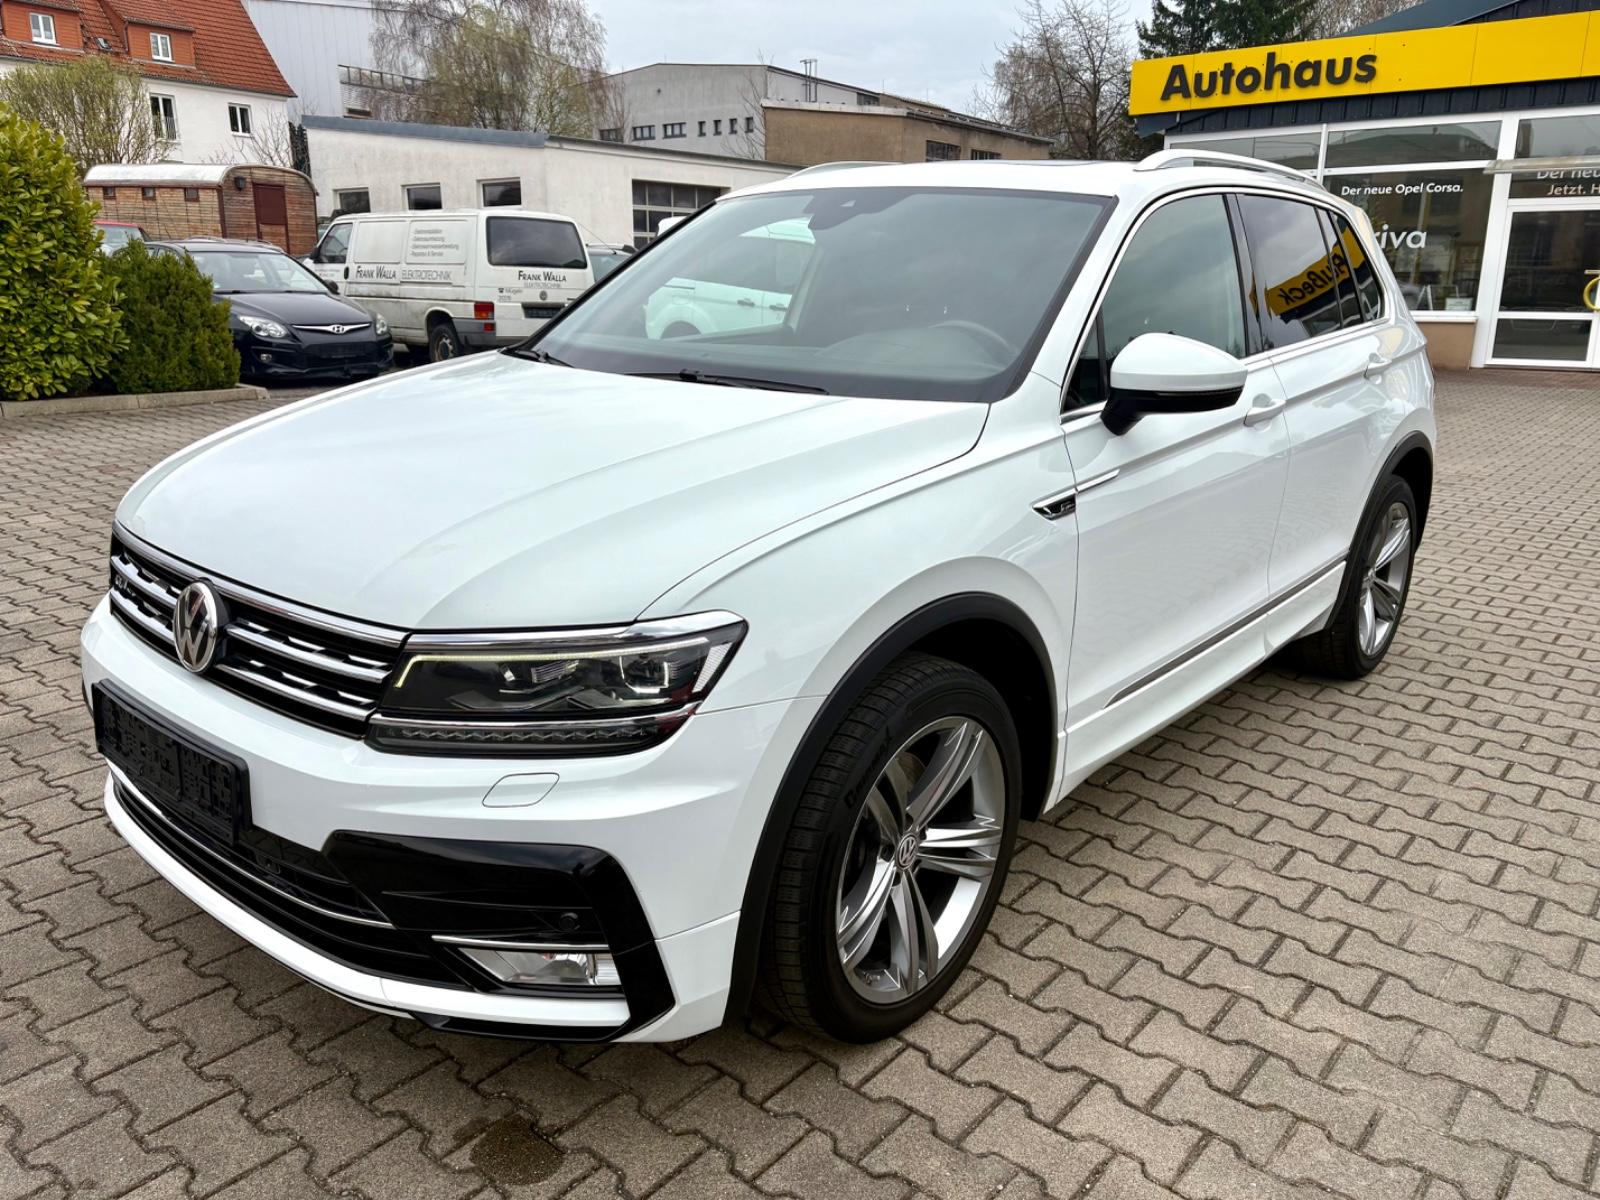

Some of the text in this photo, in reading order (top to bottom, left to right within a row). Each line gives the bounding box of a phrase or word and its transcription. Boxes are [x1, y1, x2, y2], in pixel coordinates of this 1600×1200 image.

[1159, 51, 1378, 101] Autohaus
[1536, 169, 1566, 179] Der
[1341, 182, 1464, 195] Der neue Opel Corsa.
[1547, 184, 1586, 195] Jetzt.
[355, 266, 374, 278] FRANK
[376, 265, 396, 279] WALLA
[518, 270, 567, 281] FRANK WALLA
